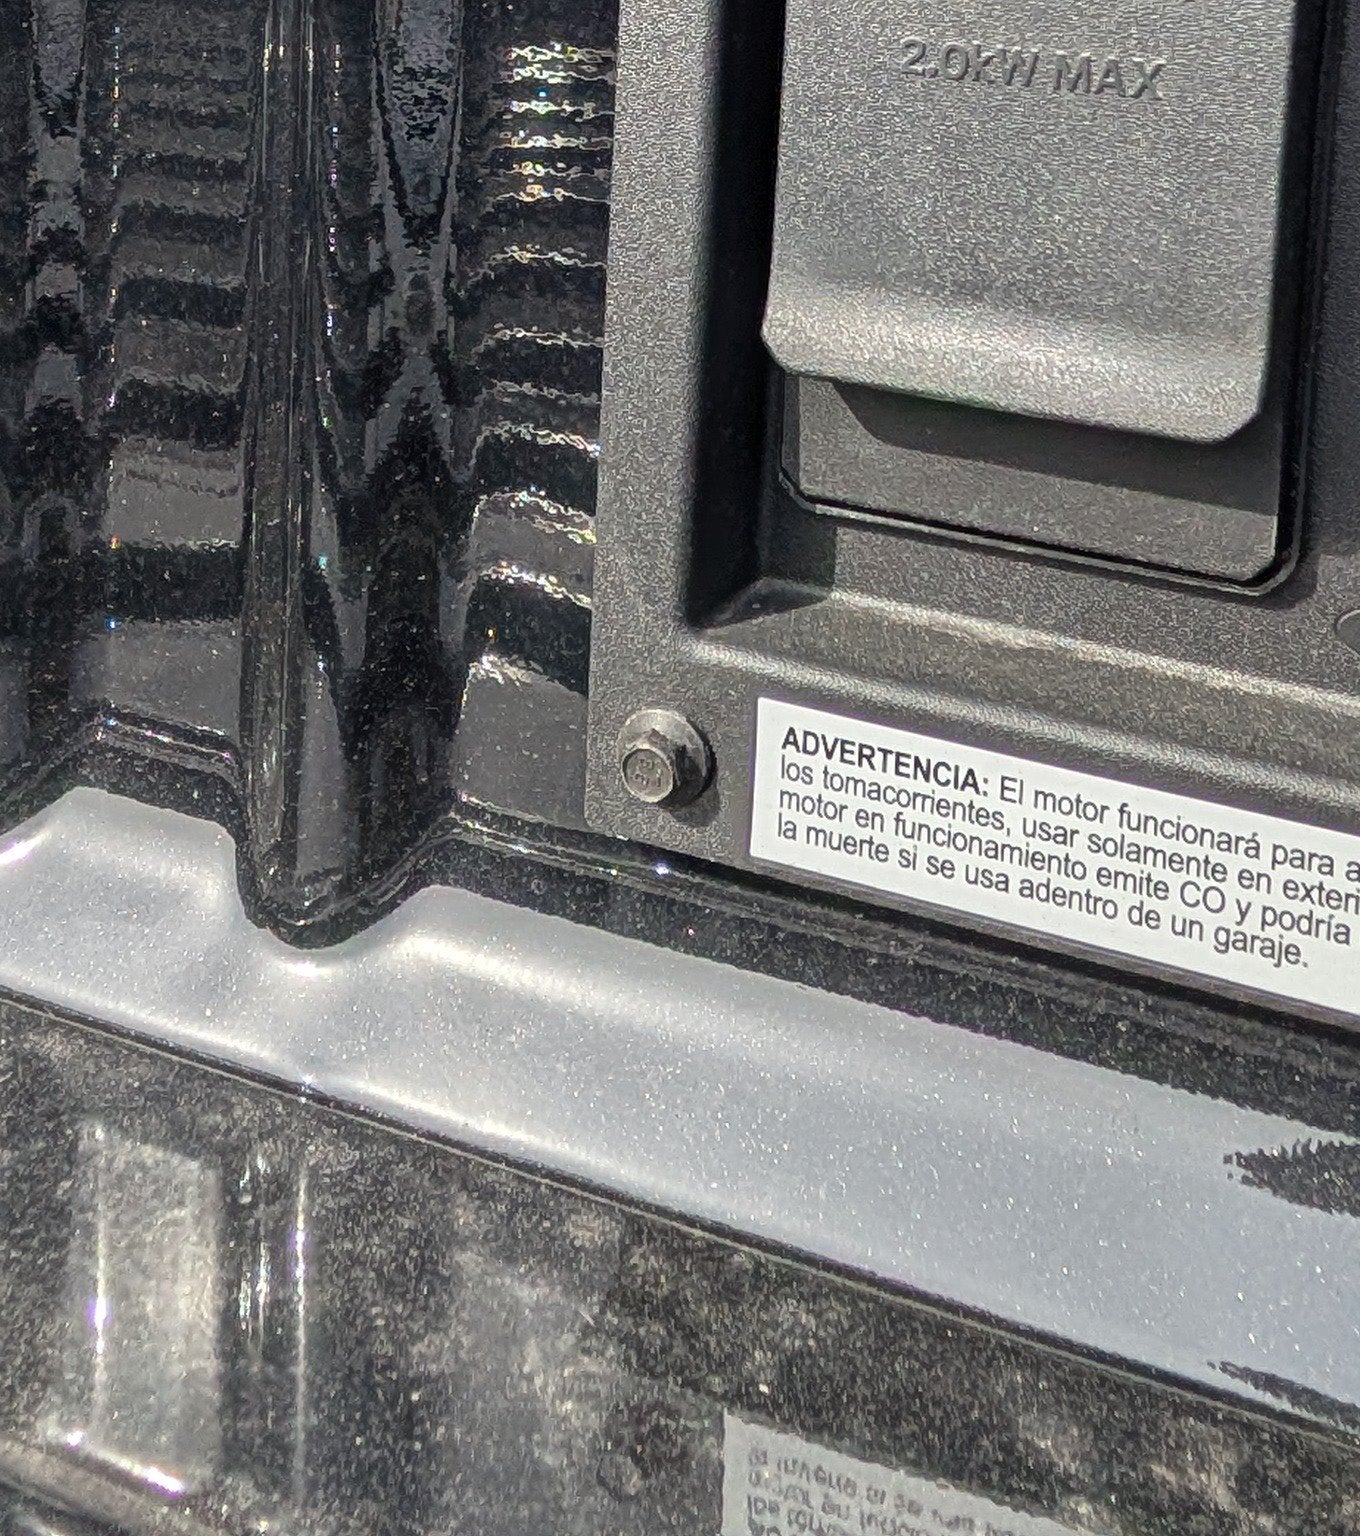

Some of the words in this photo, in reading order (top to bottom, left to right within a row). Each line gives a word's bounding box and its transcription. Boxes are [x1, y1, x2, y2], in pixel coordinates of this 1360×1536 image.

[1052, 50, 1166, 101] MAX
[779, 788, 849, 823] motor
[854, 808, 885, 834] en
[893, 810, 1088, 882] funcionamiento
[1095, 866, 1170, 902] emite
[1179, 879, 1227, 915] CO
[1234, 897, 1253, 927] y
[1259, 904, 1352, 947] podría
[780, 753, 814, 786] los
[822, 764, 1011, 838] tomacorrientes,
[1022, 816, 1081, 849] usar
[1086, 832, 1229, 885] solamente
[1237, 867, 1273, 896] en
[781, 726, 989, 798] ADVERTENCIA:
[999, 774, 1025, 806] El
[1033, 788, 1111, 825] motor
[1116, 801, 1261, 861] funcionará
[1270, 842, 1335, 878] para
[777, 811, 798, 842] la
[805, 824, 890, 864] muerte
[897, 843, 918, 872] si
[925, 854, 956, 880] se
[964, 863, 1011, 895] usa
[1018, 876, 1119, 920] adentro
[1127, 899, 1162, 931] de
[1170, 913, 1205, 943] un
[1212, 925, 1309, 969] garaje.
